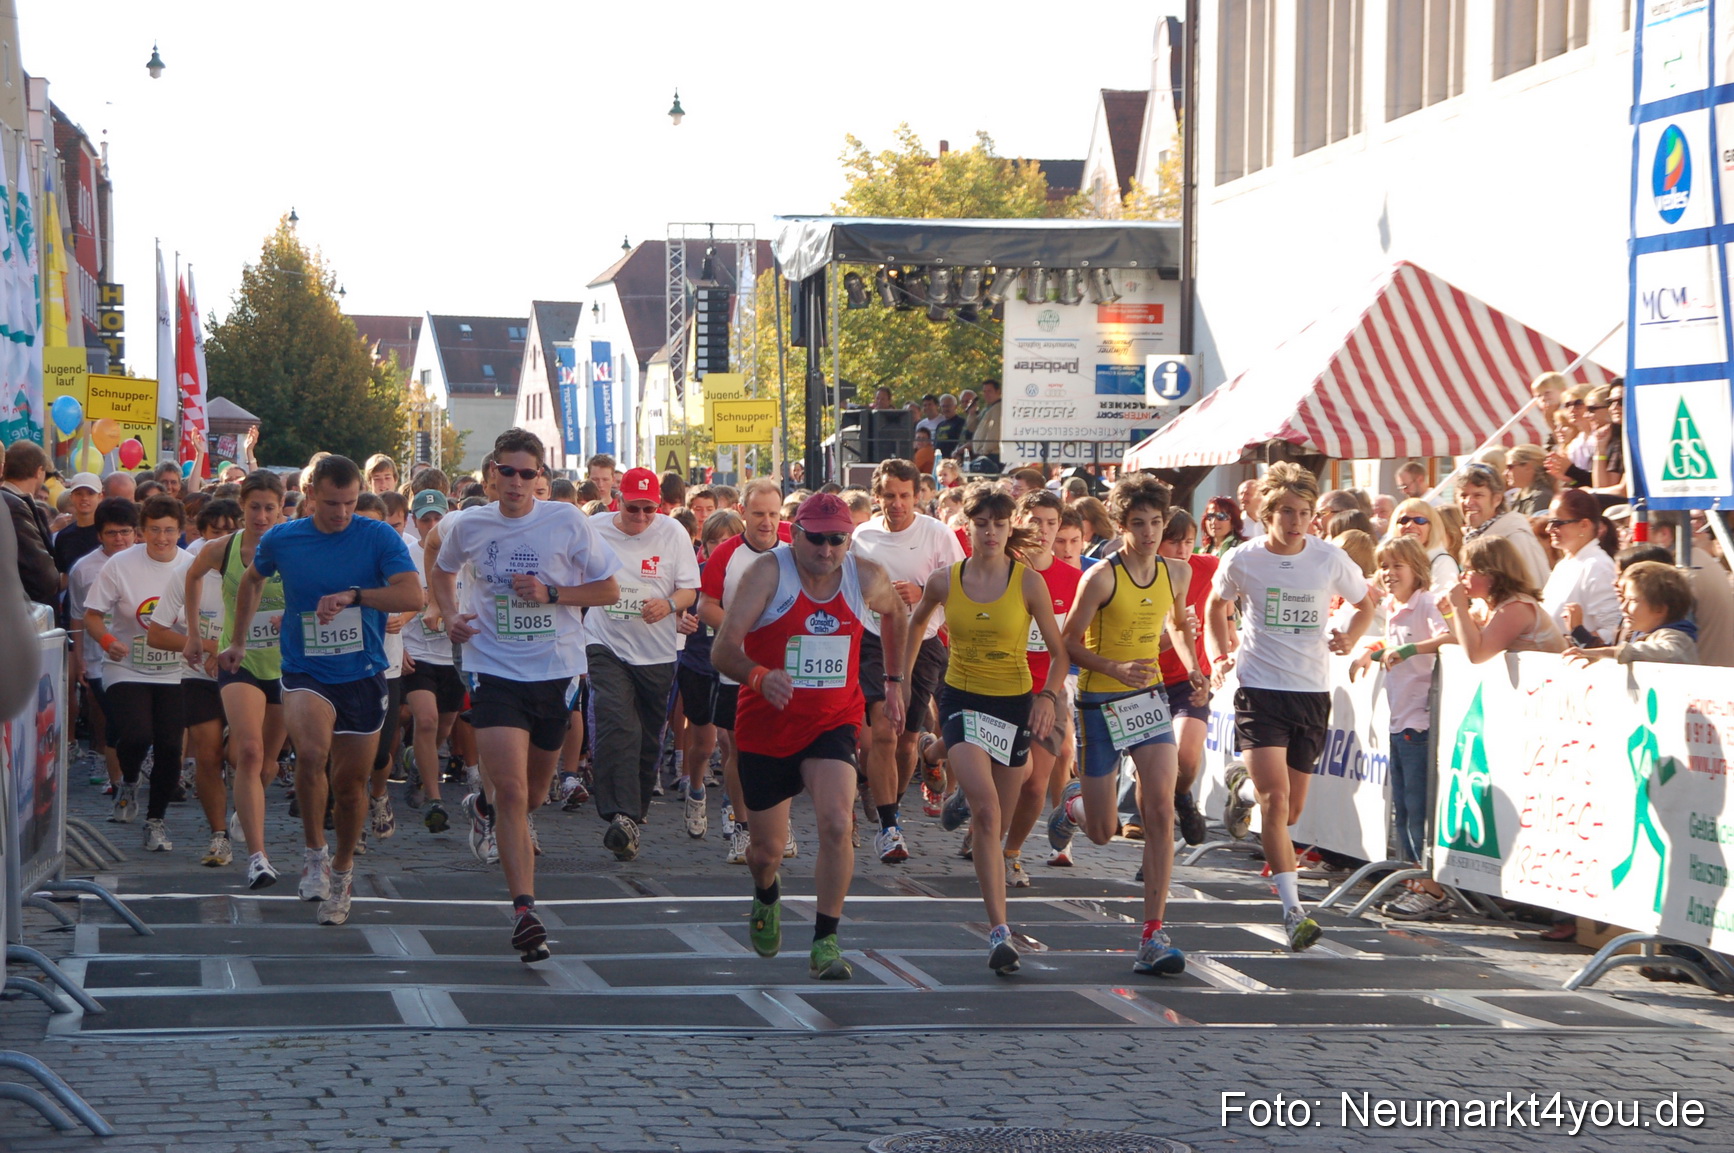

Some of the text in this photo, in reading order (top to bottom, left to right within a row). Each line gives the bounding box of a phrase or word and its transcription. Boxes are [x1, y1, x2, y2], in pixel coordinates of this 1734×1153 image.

[1014, 357, 1079, 374] Pröbster
[44, 364, 86, 379] Jugend-
[56, 376, 75, 387] lauf
[91, 387, 153, 402] Schnupper-
[111, 402, 132, 413] lauf
[602, 383, 612, 426] RUPPERT
[716, 412, 773, 423] Schnupper-
[1096, 412, 1151, 420] INTERSPORT
[735, 423, 754, 433] lauf
[1013, 427, 1126, 436] AKTIENGESELLSCHAFT
[658, 435, 686, 446] Block
[664, 450, 683, 475] A
[425, 494, 435, 504] B
[619, 584, 639, 594] erner
[1282, 592, 1315, 603] Benedikt
[511, 599, 541, 609] Markus
[1282, 609, 1319, 623] 5128
[513, 614, 553, 630] 5085
[320, 627, 358, 643] 5165
[147, 651, 177, 661] 5011
[803, 658, 844, 674] 5186
[1117, 703, 1140, 714] Kevin
[977, 711, 1007, 730] Vanessa
[1126, 708, 1164, 732] 5080
[979, 726, 1008, 751] 5000
